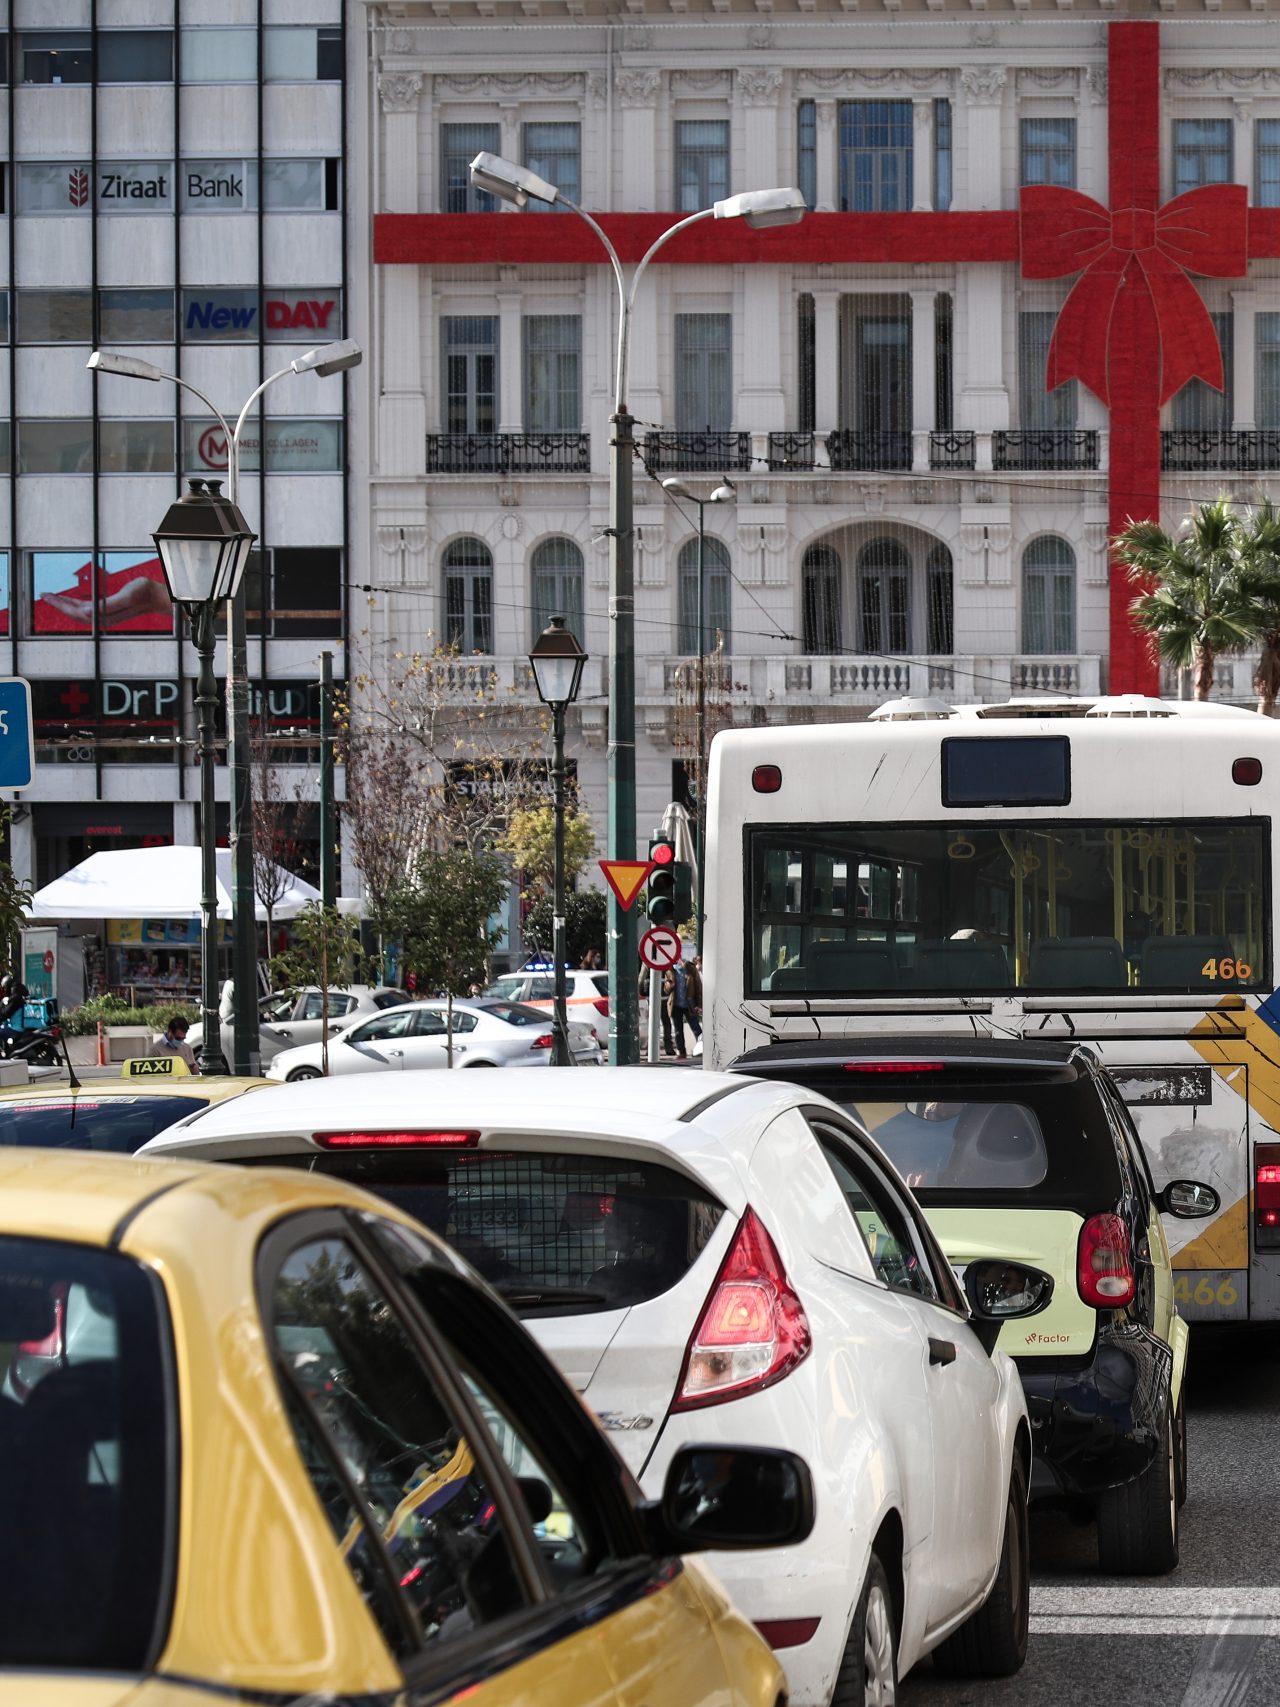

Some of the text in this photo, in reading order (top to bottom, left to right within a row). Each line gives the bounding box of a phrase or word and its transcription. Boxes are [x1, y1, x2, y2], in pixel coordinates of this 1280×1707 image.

[101, 174, 243, 198] Ziraat Bank
[186, 301, 336, 330] New DAY
[102, 681, 148, 715] Dr
[86, 826, 123, 834] everest
[1201, 958, 1252, 980] 466
[133, 1060, 170, 1074] TAXI
[1174, 1276, 1237, 1306] 466
[1025, 1333, 1070, 1345] HP Factor
